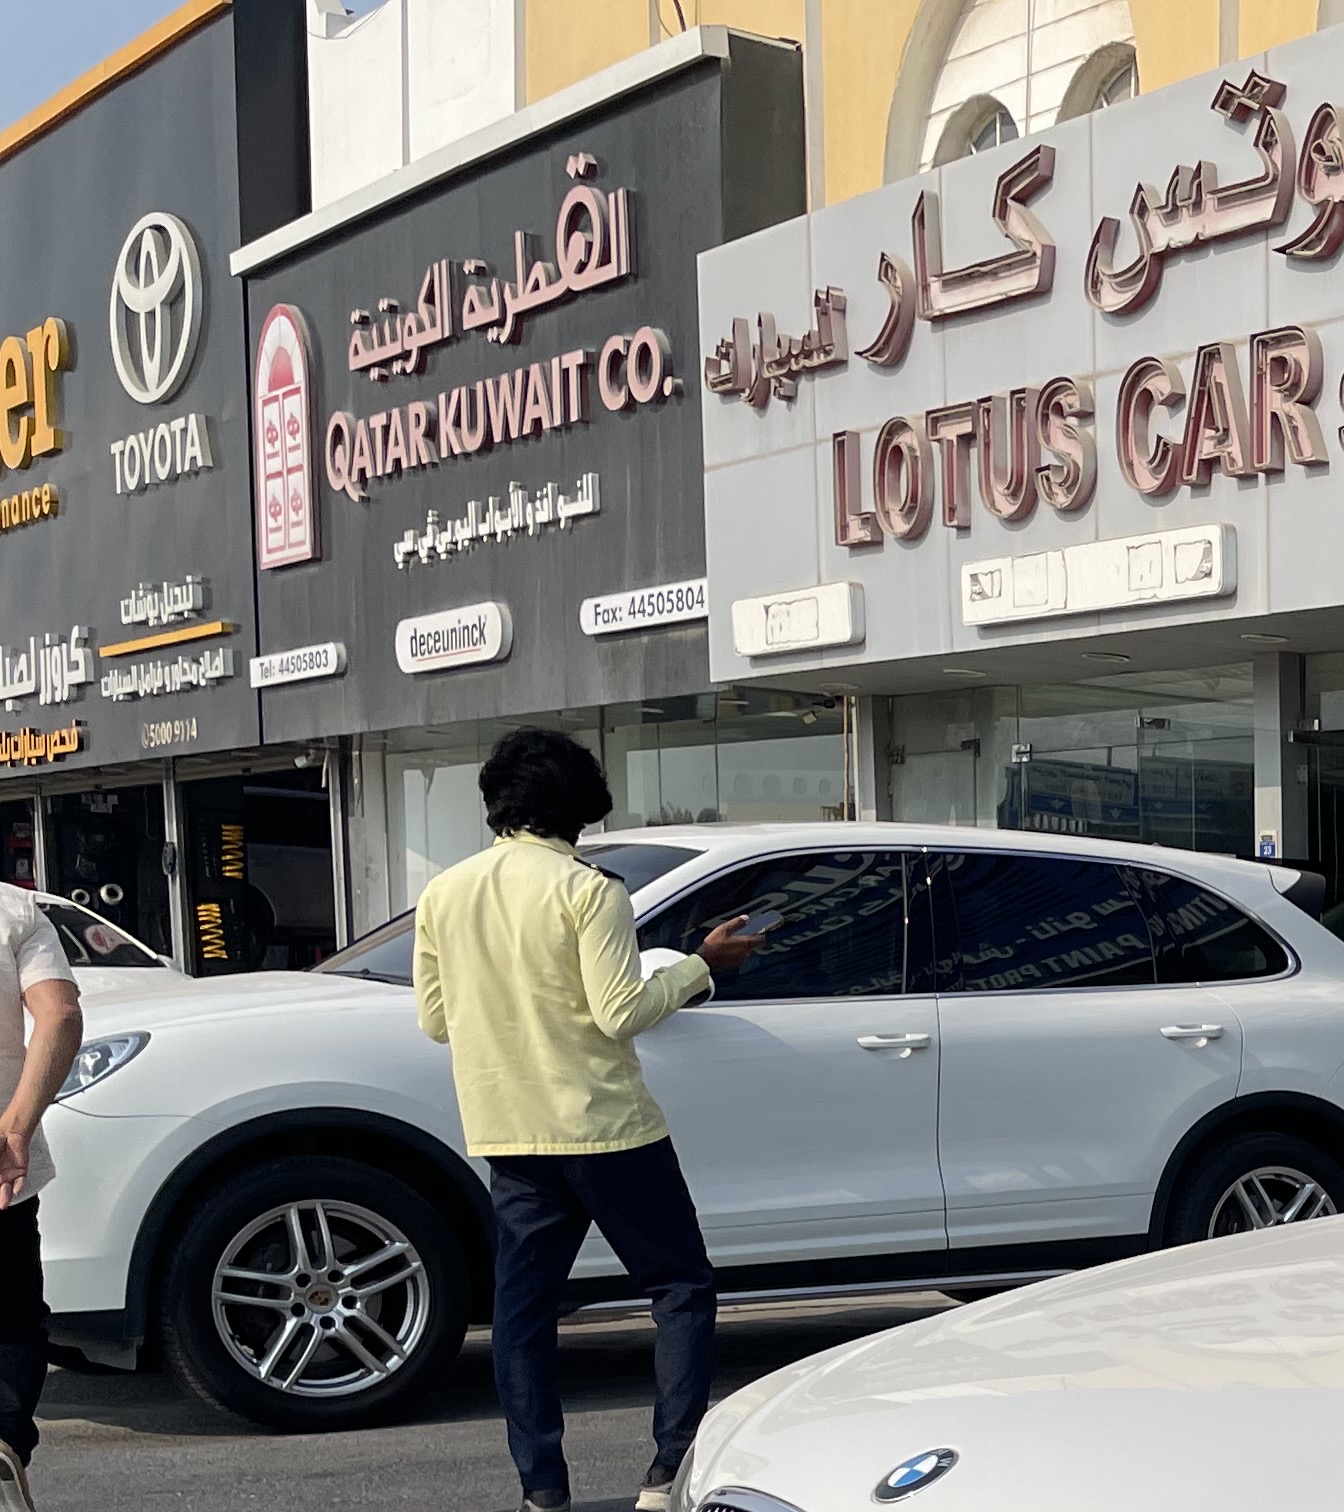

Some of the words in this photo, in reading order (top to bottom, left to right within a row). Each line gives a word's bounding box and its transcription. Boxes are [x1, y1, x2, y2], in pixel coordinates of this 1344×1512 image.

[462, 152, 634, 345] القطرية
[855, 145, 1056, 367] كار
[348, 258, 454, 383] الكويتية
[110, 412, 213, 495] TOYOTA
[325, 400, 439, 502] QATAR
[438, 348, 590, 460] KUWAIT
[598, 325, 682, 412] CO.
[832, 375, 1099, 548] LOTUS
[1115, 324, 1330, 496] CAR
[258, 660, 276, 681] Tel:
[278, 648, 330, 677] 44505803
[410, 613, 488, 659] deceuninck
[593, 602, 624, 627] Fax:
[627, 584, 706, 620] 44505804
